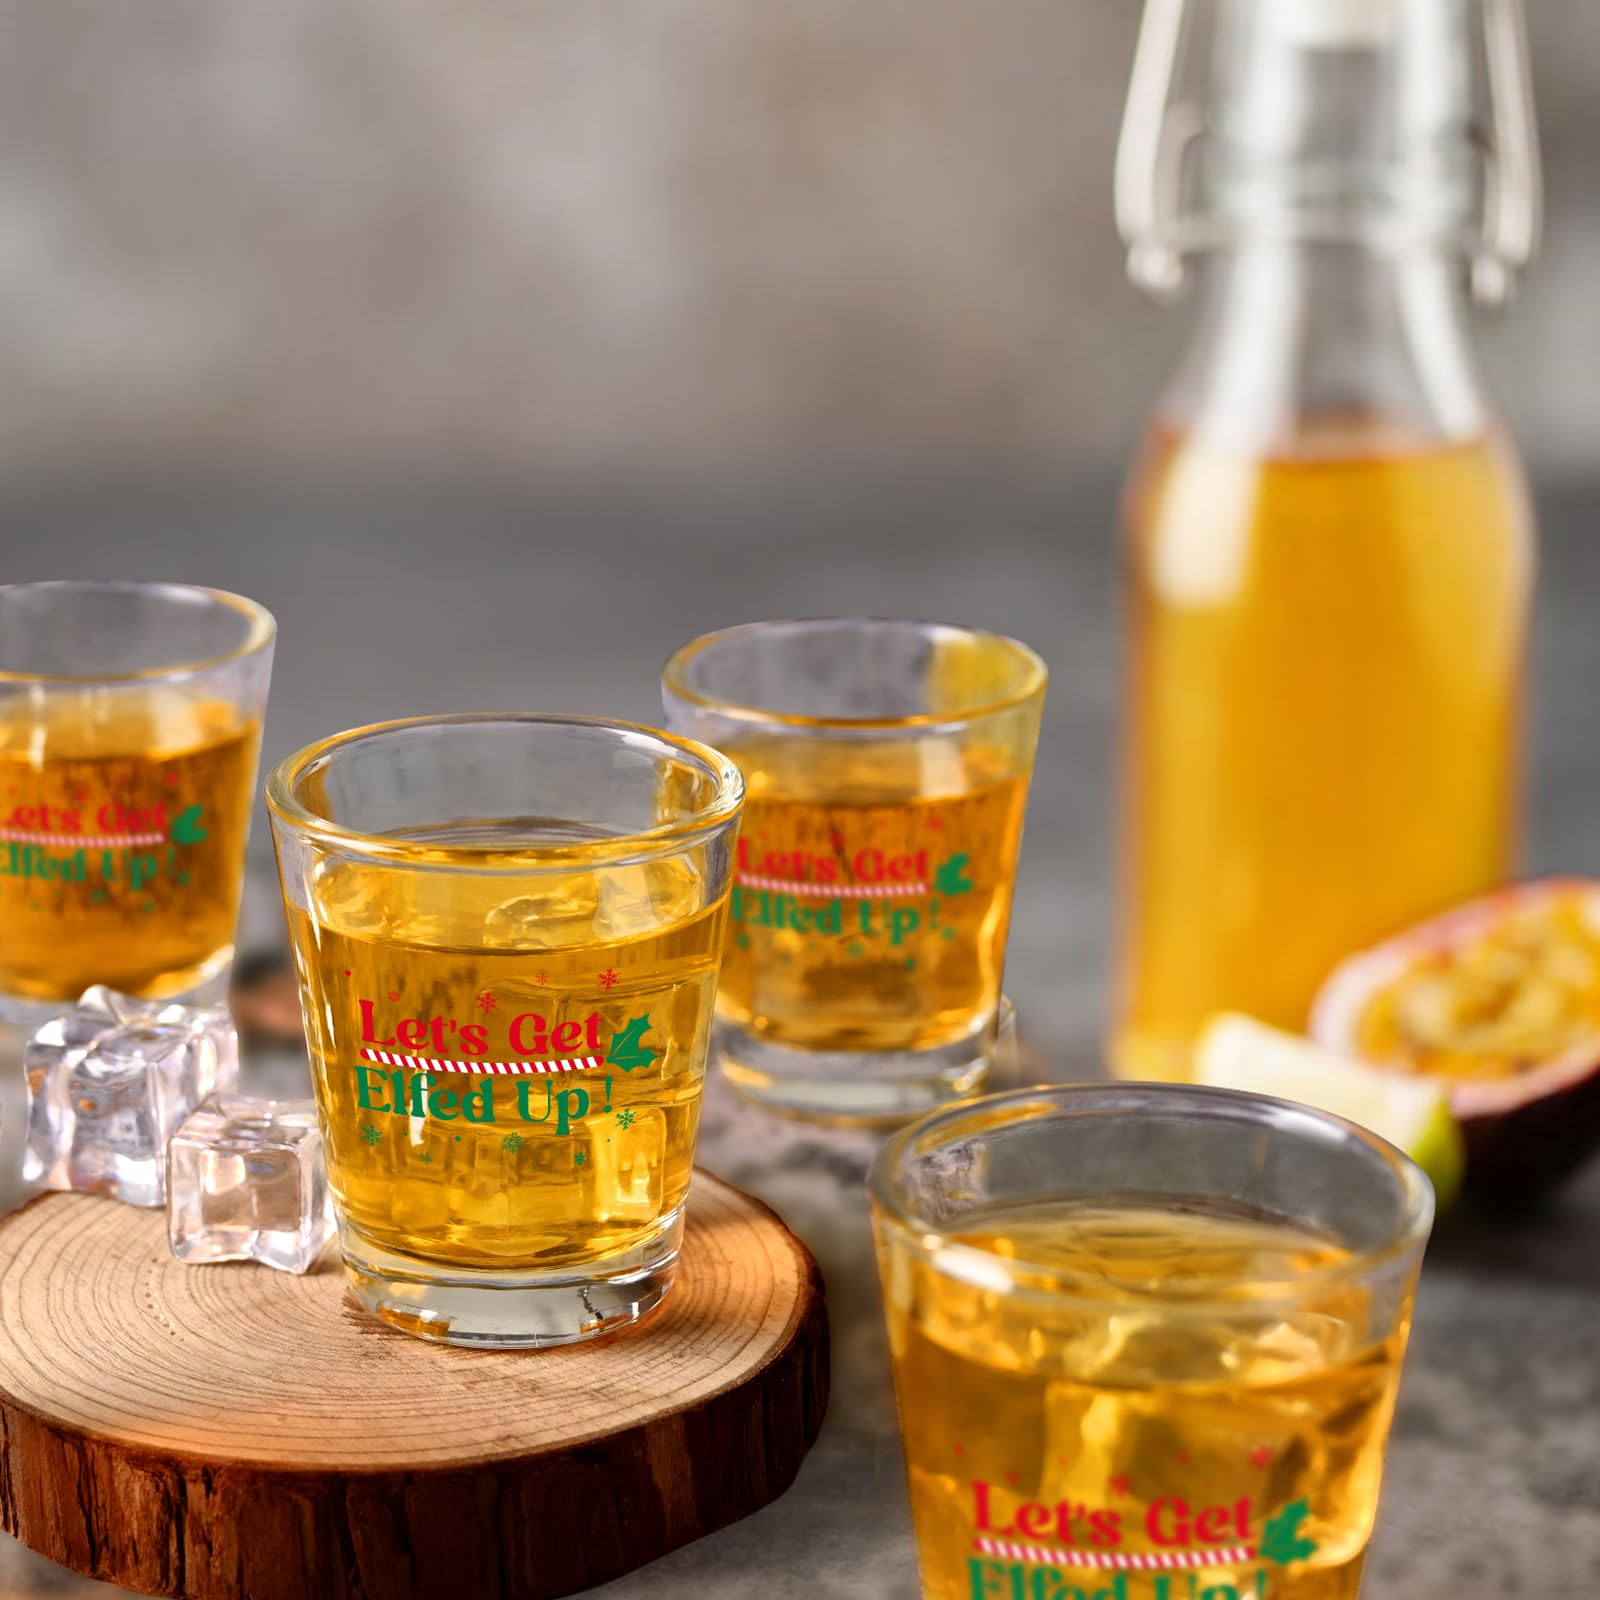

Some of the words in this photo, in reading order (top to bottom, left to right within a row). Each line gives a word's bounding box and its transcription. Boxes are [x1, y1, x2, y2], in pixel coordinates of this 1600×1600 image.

[97, 801, 166, 834] Get
[737, 835, 839, 884] Let's
[853, 848, 927, 883] Get
[732, 887, 842, 935] Elfed
[359, 999, 489, 1056] Let's
[509, 1011, 604, 1055] Get
[355, 1066, 496, 1123] Elfed
[971, 1479, 1123, 1547] Let's
[1145, 1495, 1255, 1547] Get
